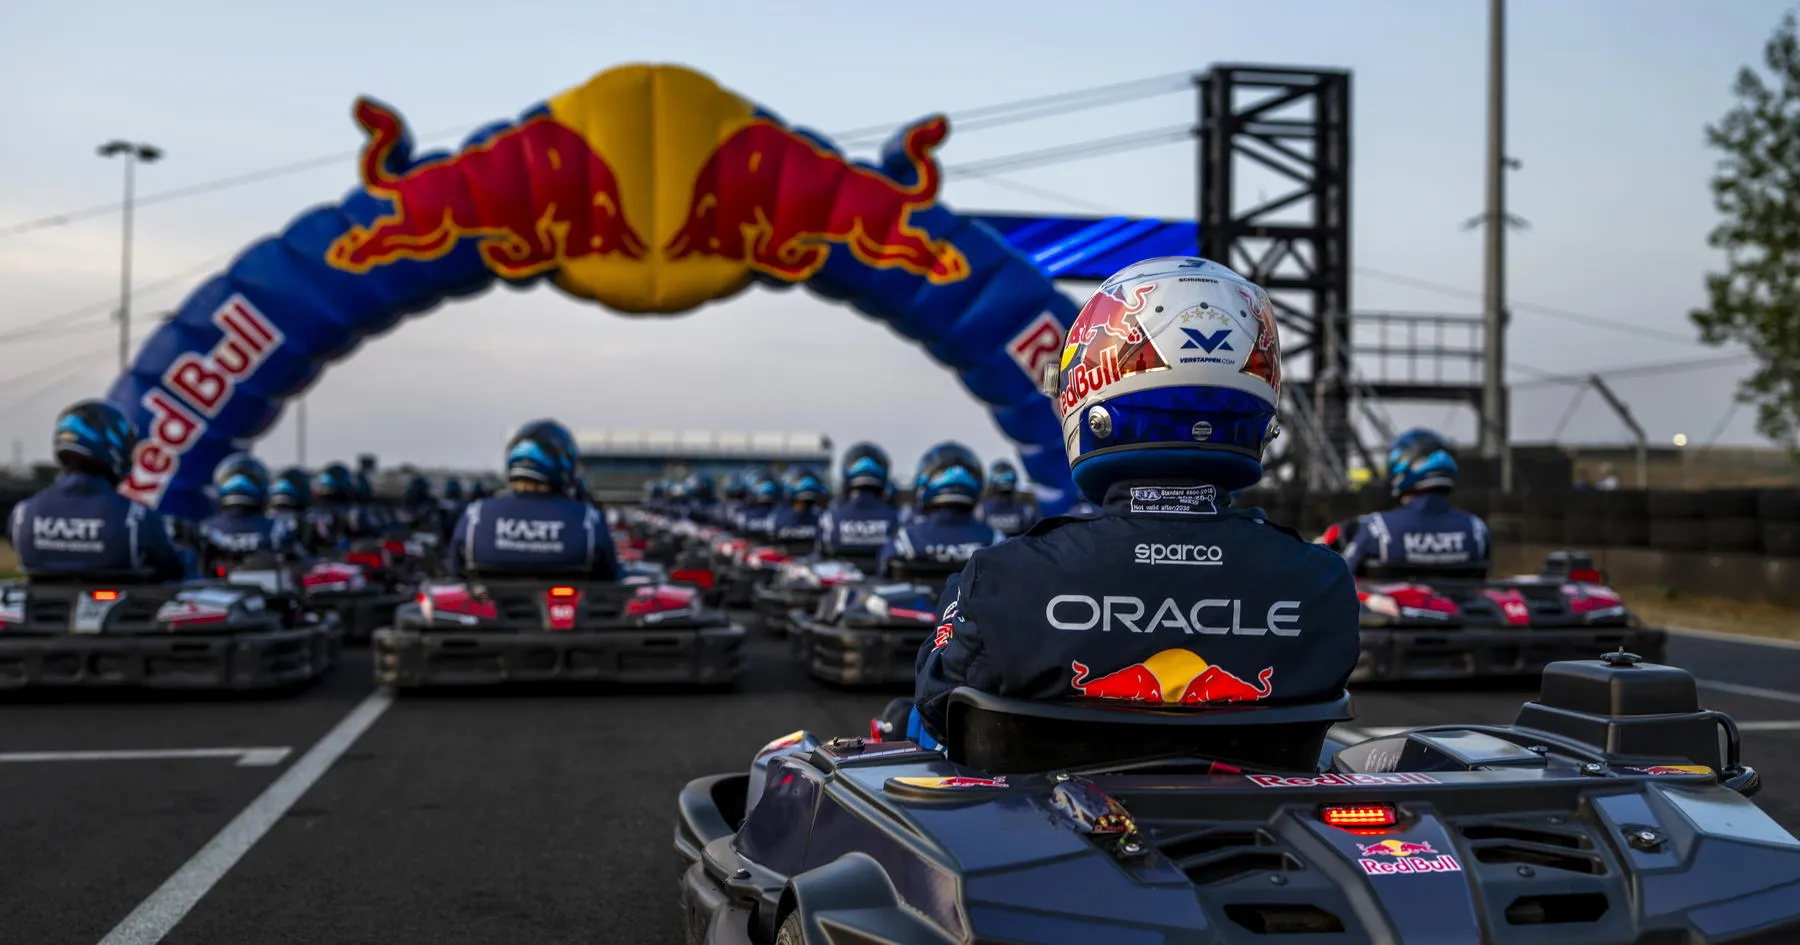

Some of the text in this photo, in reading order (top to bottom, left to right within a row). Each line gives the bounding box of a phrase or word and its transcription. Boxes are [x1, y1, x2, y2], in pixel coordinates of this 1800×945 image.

[161, 292, 286, 419] Bull
[1180, 357, 1235, 365] VERSTAPPEN.COM
[1073, 345, 1121, 400] Bull
[32, 516, 105, 540] KART
[495, 518, 566, 541] KART
[1403, 531, 1466, 552] KART
[1134, 543, 1223, 565] sparco
[1045, 595, 1302, 637] ORACLE
[1246, 773, 1443, 788] Red Bull
[1358, 854, 1462, 875] Red Bull
